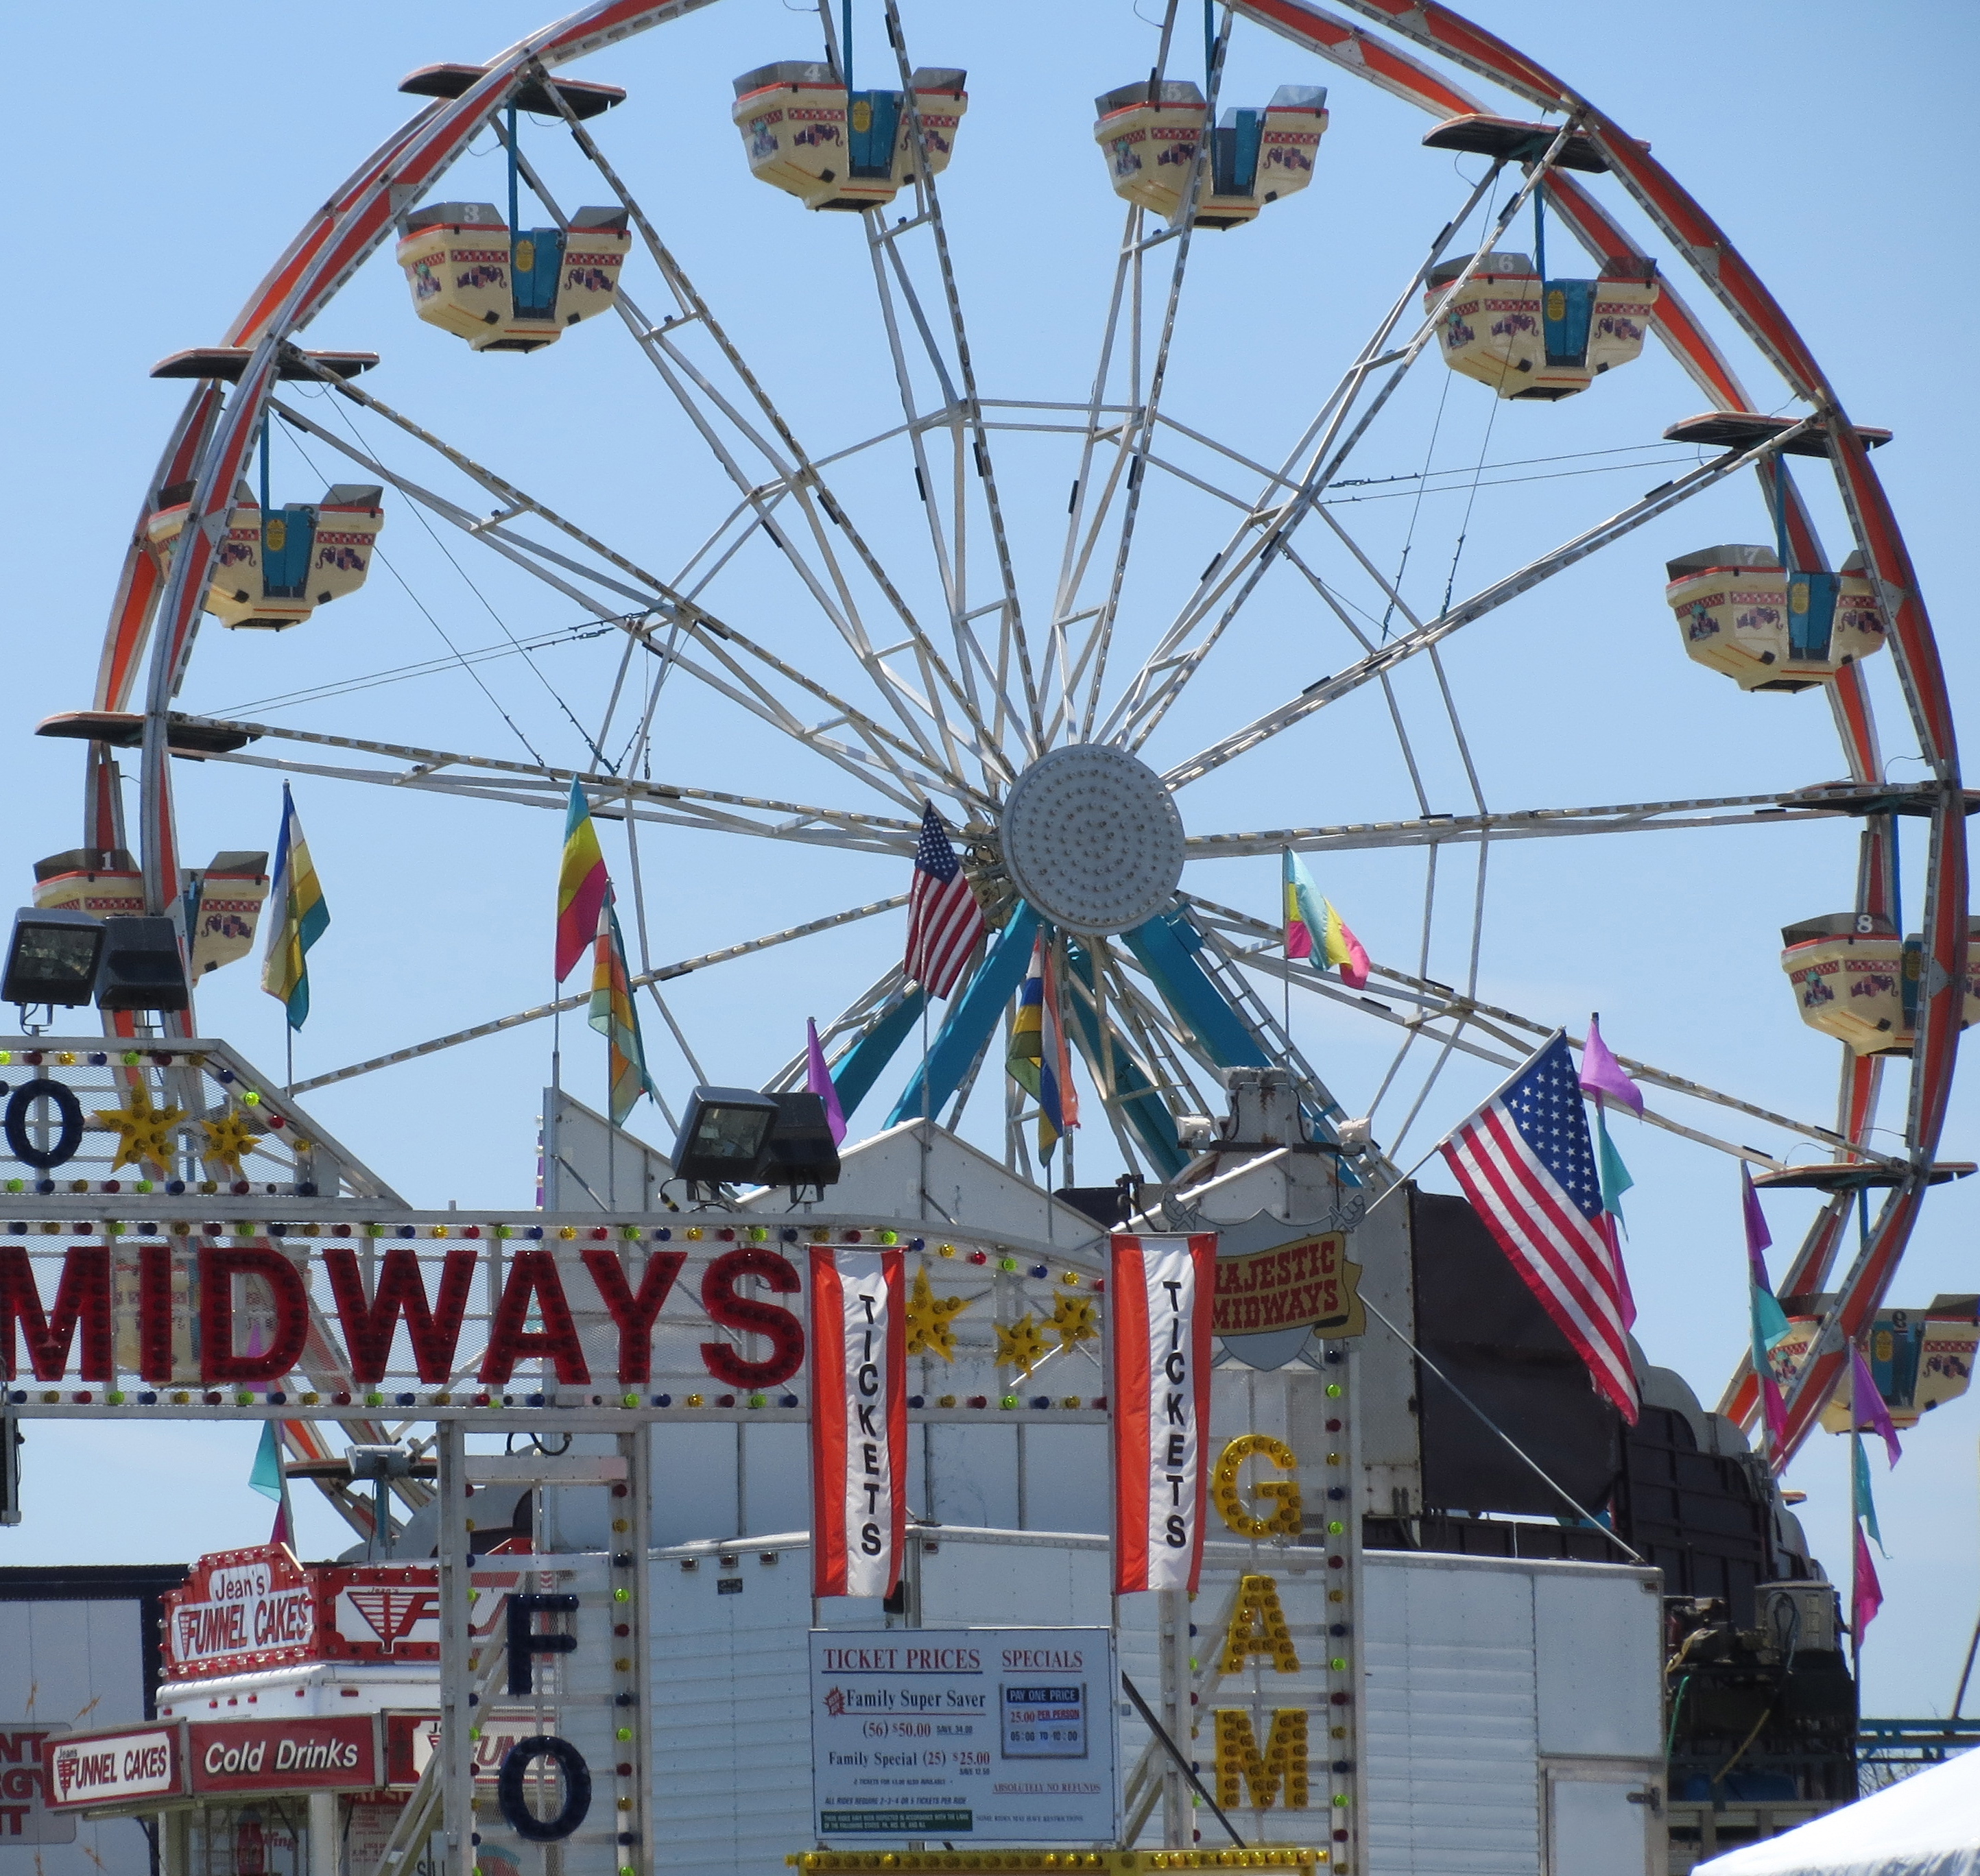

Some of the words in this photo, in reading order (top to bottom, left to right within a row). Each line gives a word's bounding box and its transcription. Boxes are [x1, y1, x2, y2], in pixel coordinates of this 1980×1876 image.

[804, 64, 821, 82] 4
[464, 204, 479, 223] 3
[1499, 254, 1514, 272] 6
[1744, 547, 1760, 566] 7
[102, 851, 114, 871] 1
[1857, 914, 1873, 933] 8
[0, 1246, 805, 1389] MIDWAYS
[1162, 1281, 1186, 1548] TICKETS
[859, 1294, 882, 1556] TICKETS
[215, 1570, 265, 1601] Jean's
[178, 1604, 248, 1660] FUNNEL
[254, 1593, 313, 1646] CAKES
[824, 1648, 898, 1669] TICKET
[907, 1648, 981, 1669] PRICES
[1002, 1650, 1082, 1668] SPECIALS
[846, 1689, 895, 1710] Family
[900, 1689, 942, 1711] Super
[947, 1689, 986, 1707] Saver
[1010, 1689, 1025, 1700] PAY
[1029, 1689, 1047, 1701] ONE
[1050, 1689, 1075, 1701] PRICE
[1010, 1711, 1035, 1723] 25.00
[863, 1720, 889, 1739] (56)
[893, 1722, 931, 1737] $50.00
[205, 1740, 266, 1774] Cold
[275, 1738, 358, 1770] Drinks
[828, 1751, 868, 1768] Family
[874, 1751, 917, 1768] Special
[922, 1749, 946, 1767] (25)
[953, 1751, 990, 1766] $25.00
[57, 1753, 117, 1800] FUNNEL
[123, 1745, 167, 1781] CAKES
[1047, 1783, 1058, 1792] NO
